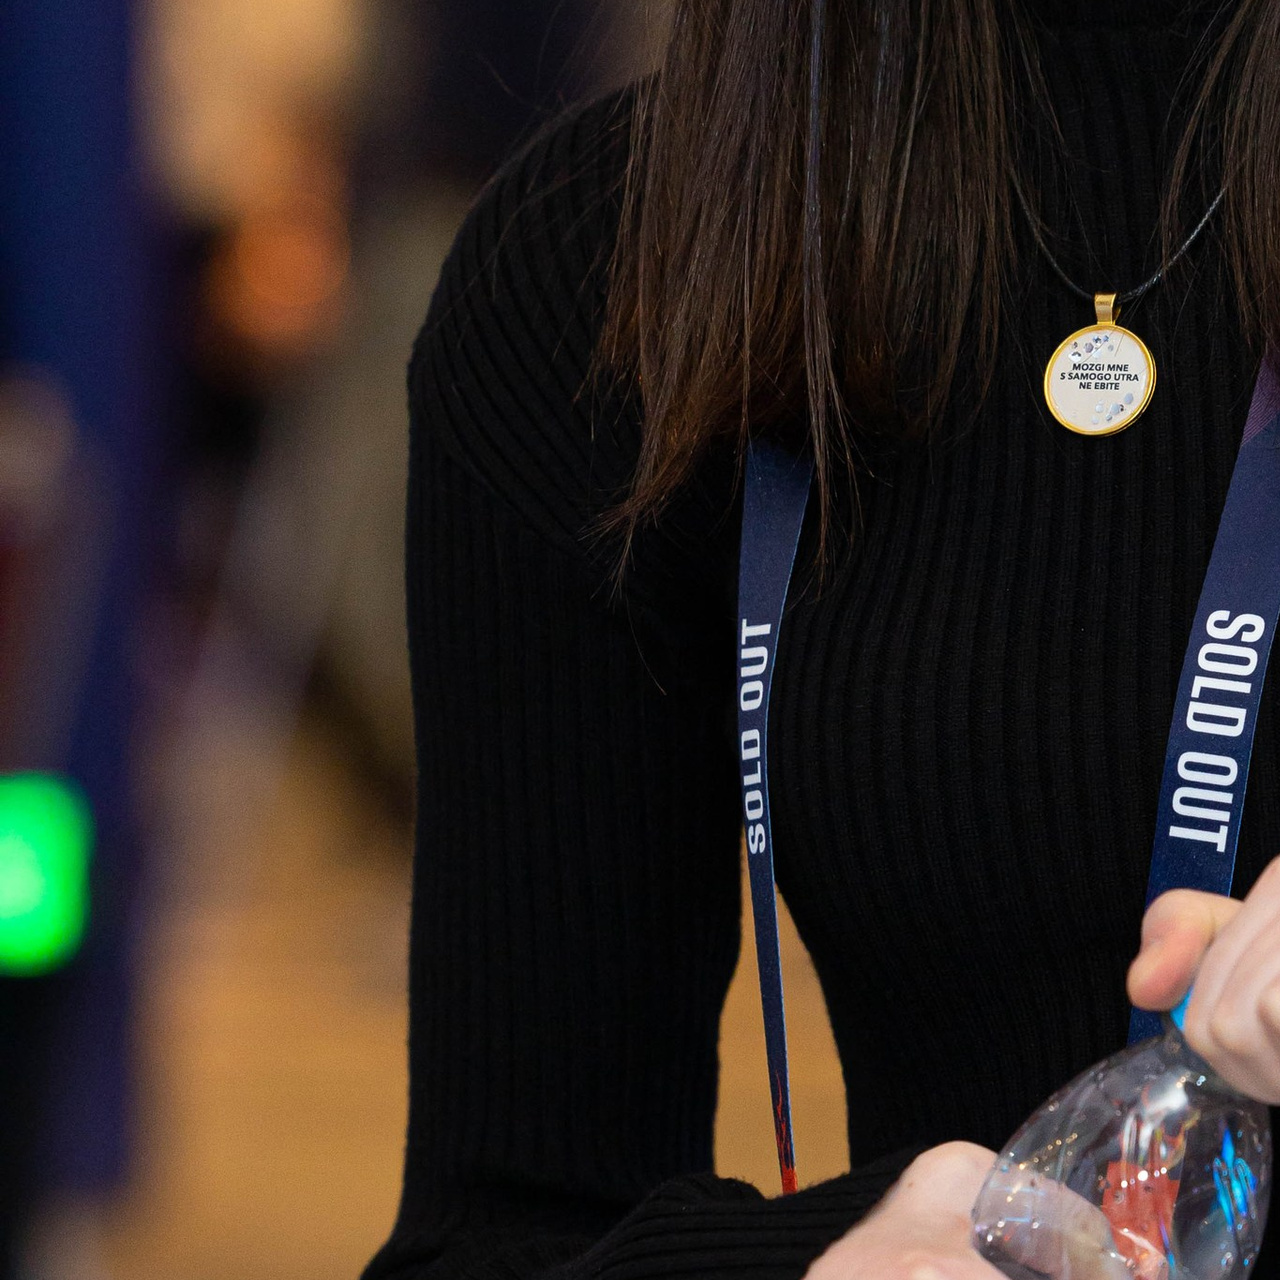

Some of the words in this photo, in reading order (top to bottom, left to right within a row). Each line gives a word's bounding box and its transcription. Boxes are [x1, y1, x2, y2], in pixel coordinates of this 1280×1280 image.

[1060, 372, 1066, 380] S
[1067, 372, 1111, 381] SAMOGO
[1114, 373, 1139, 382] UTRA
[1072, 363, 1105, 372] MOZGI
[1107, 363, 1129, 372] MNE
[1078, 381, 1092, 390] NE
[1094, 382, 1120, 391] EBITE
[740, 618, 771, 711] OUT
[1185, 609, 1266, 737] SOLD
[741, 728, 766, 855] SOLD
[1168, 751, 1238, 853] OUT
